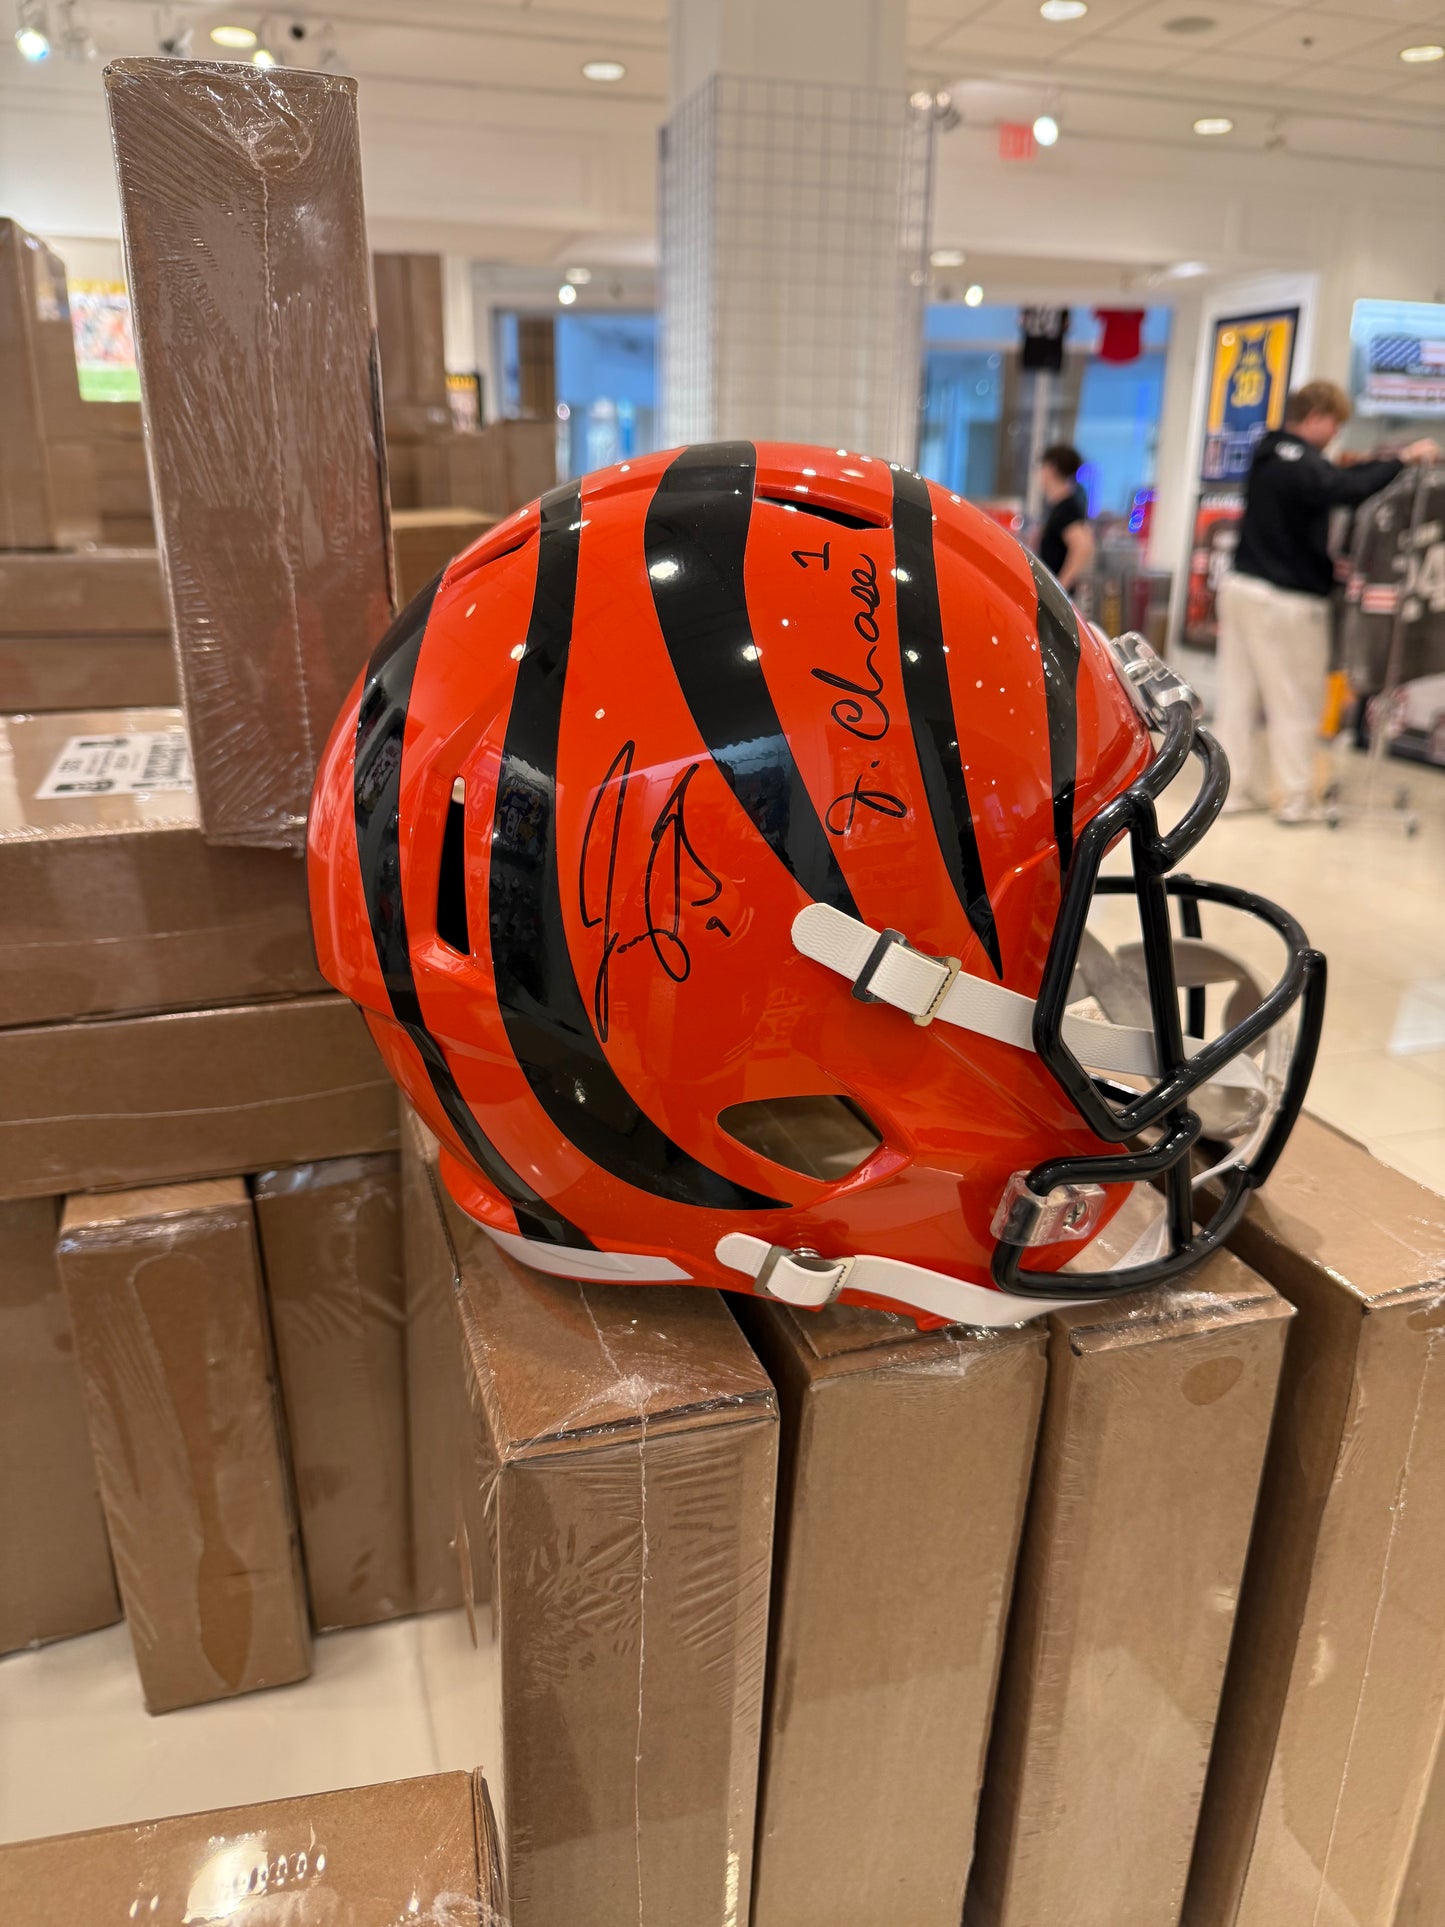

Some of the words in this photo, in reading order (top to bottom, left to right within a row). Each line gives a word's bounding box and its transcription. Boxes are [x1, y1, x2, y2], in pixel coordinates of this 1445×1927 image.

[791, 541, 831, 571] 1
[810, 553, 890, 741] Chase
[706, 916, 732, 938] 9
